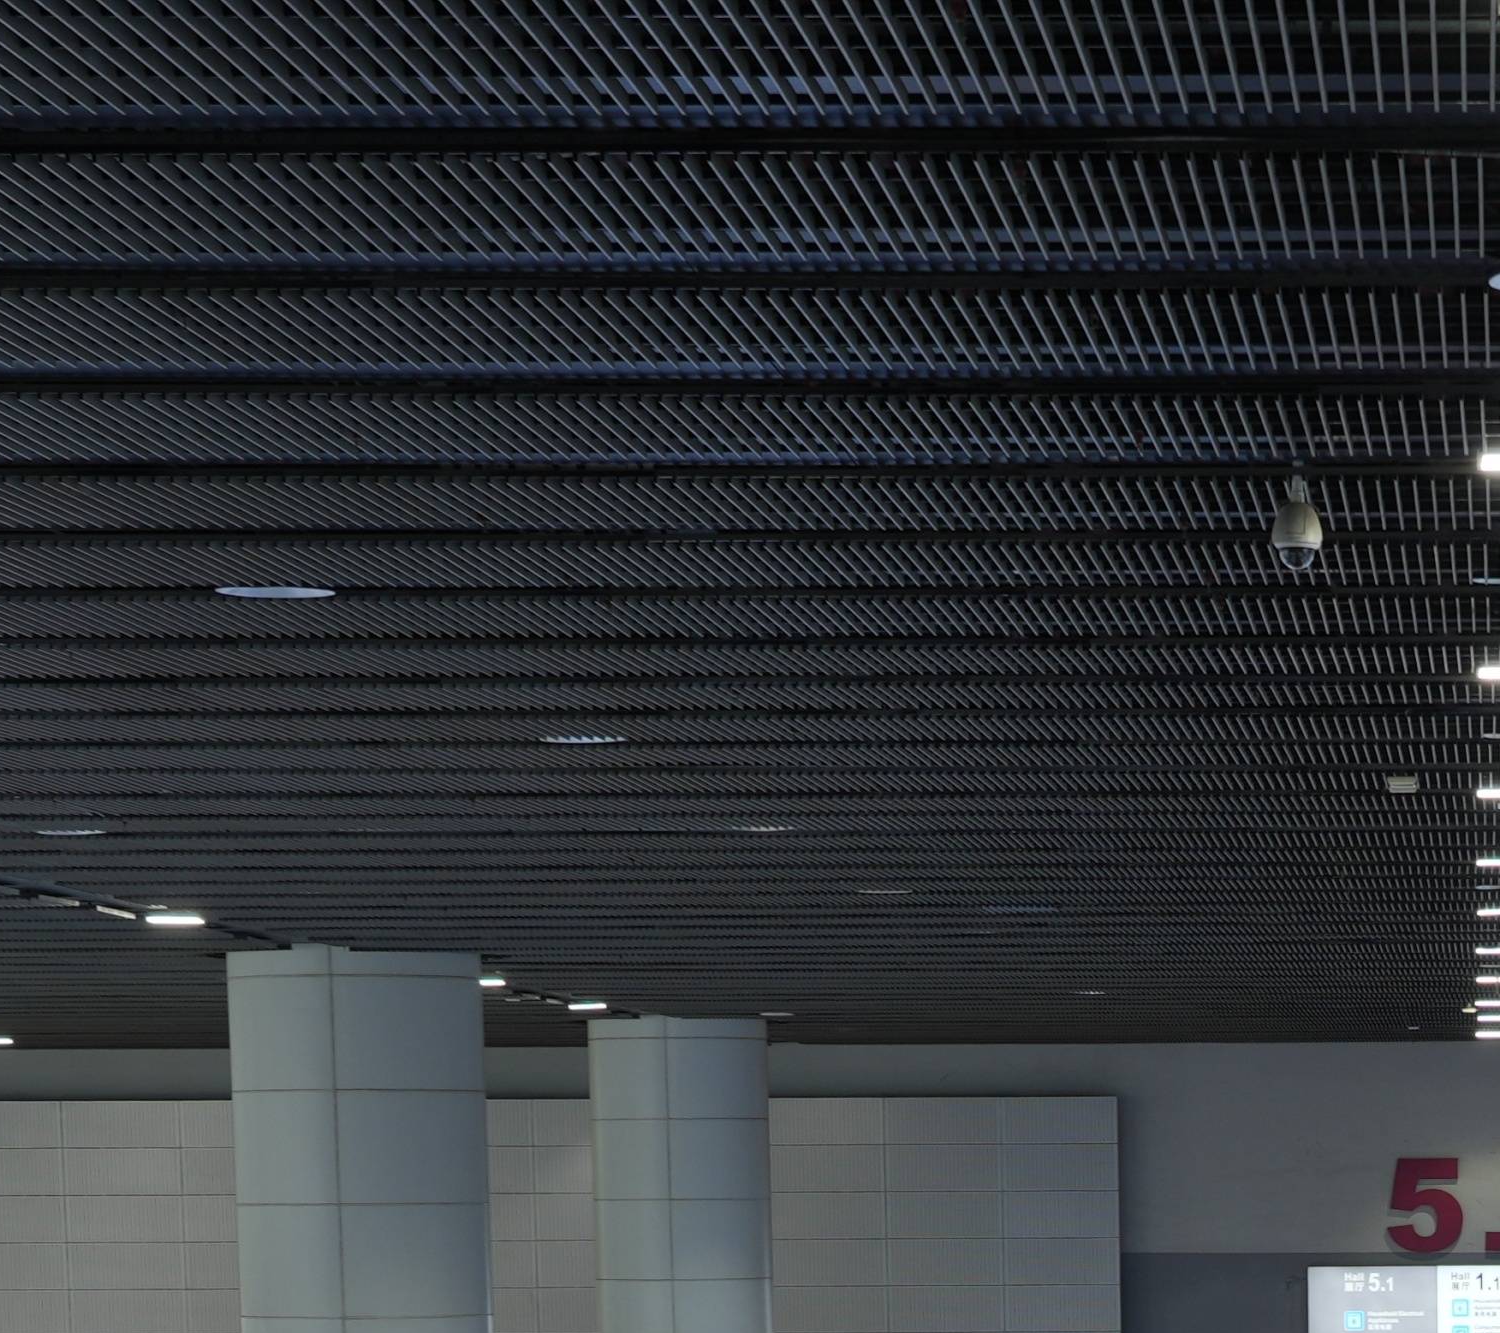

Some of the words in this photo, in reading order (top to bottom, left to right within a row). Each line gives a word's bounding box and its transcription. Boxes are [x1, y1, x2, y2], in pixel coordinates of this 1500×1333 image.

[1344, 1273, 1364, 1281] Hall
[1451, 1272, 1470, 1280] Hall
[1369, 1273, 1394, 1291] 5.1
